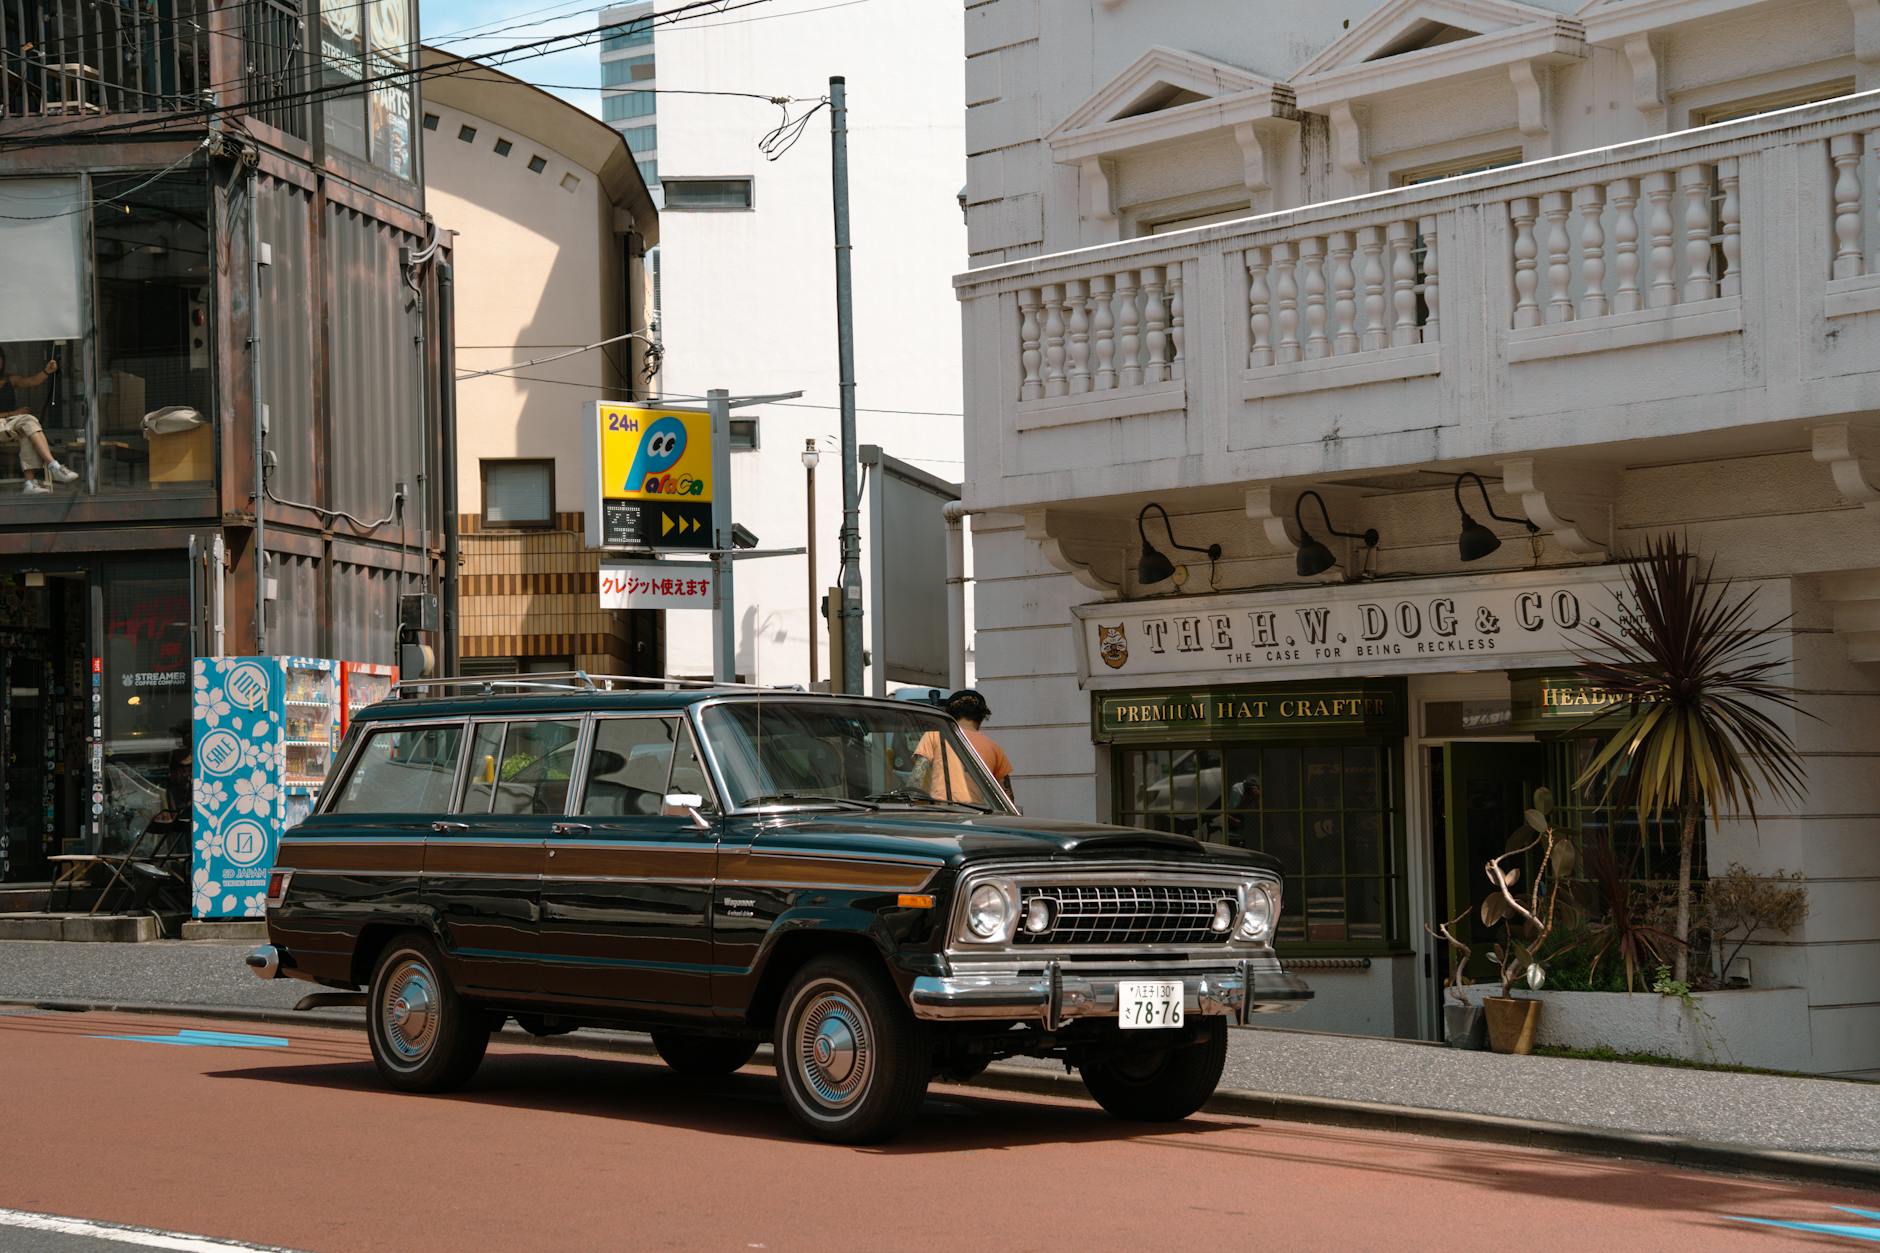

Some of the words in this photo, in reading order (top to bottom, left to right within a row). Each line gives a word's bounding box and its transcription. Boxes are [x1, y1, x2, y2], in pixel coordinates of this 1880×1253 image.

[608, 413, 639, 432] 24H
[602, 577, 710, 597] クレジット使えます
[1142, 614, 1233, 654] THE
[1358, 598, 1458, 641] DOG
[1475, 606, 1500, 635] &
[1515, 590, 1600, 632] CO.
[1227, 653, 1252, 664] THE
[1266, 649, 1300, 662] CASE
[1316, 647, 1341, 659] FOR
[1357, 644, 1400, 656] BEING
[1418, 638, 1496, 653] RECKLESS
[134, 672, 186, 681] STREAMER
[1116, 703, 1206, 723] PREMIUM
[1217, 701, 1269, 719] HAT
[206, 737, 236, 769] SALE
[236, 867, 267, 879] JAPAN
[1134, 1000, 1180, 1025] 78-76
